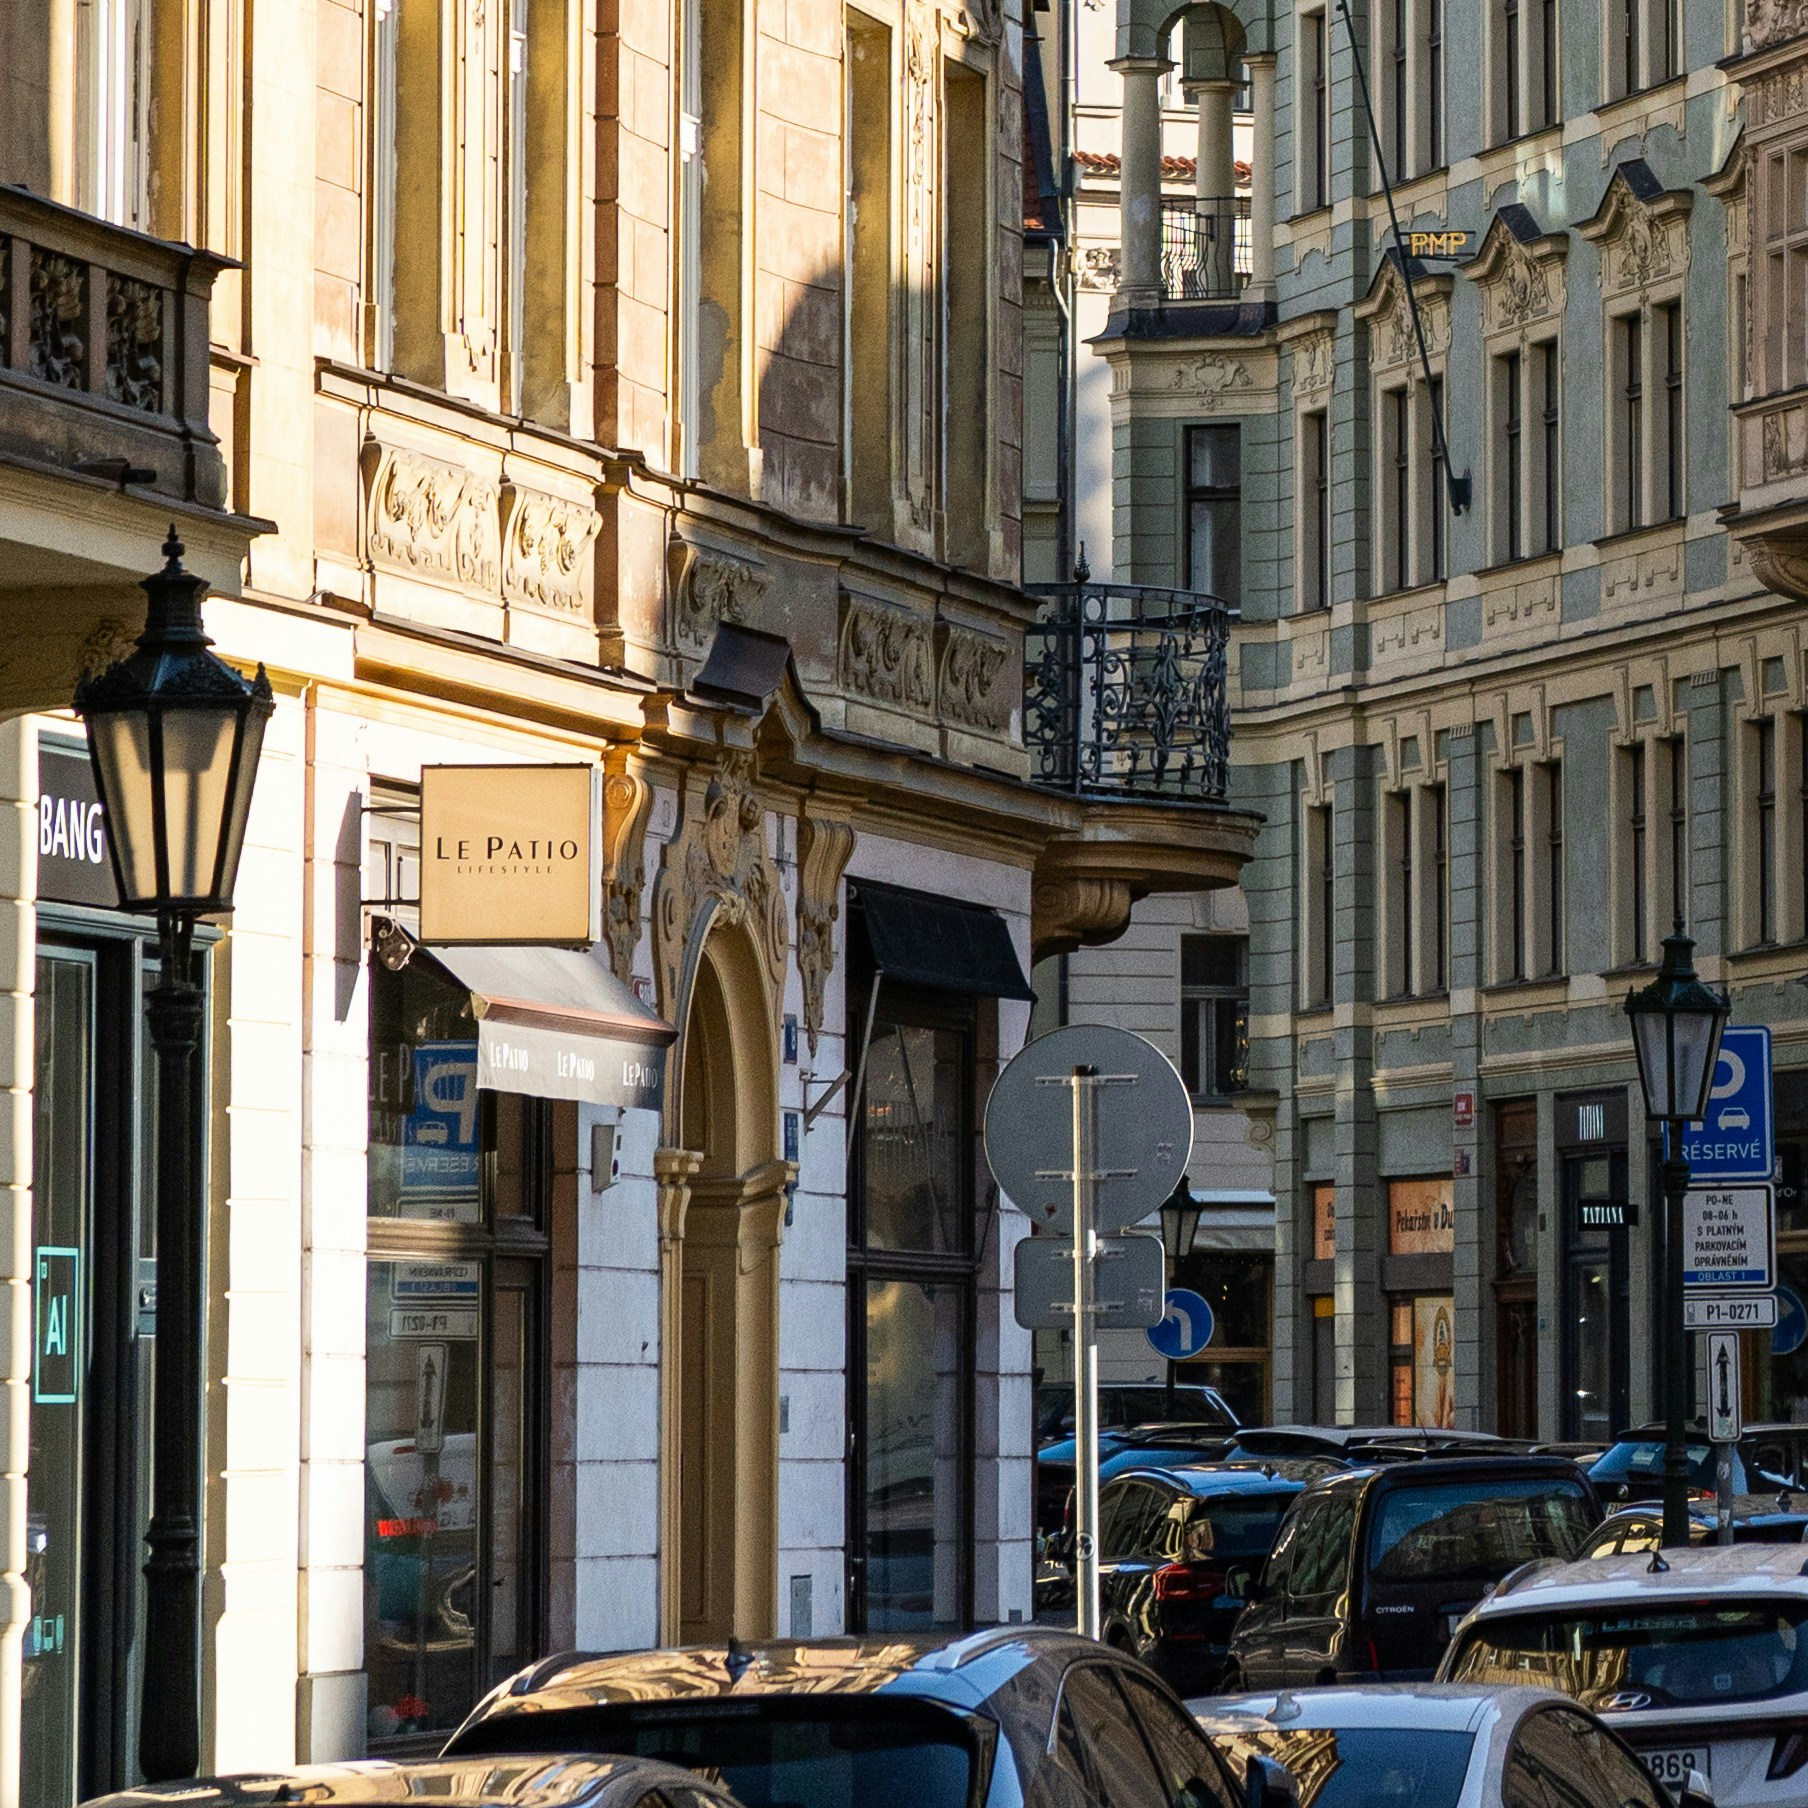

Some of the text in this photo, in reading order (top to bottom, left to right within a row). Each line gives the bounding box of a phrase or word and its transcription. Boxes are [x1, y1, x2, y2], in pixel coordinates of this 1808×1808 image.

[41, 794, 103, 864] BANG
[457, 865, 553, 874] LIFESTYLE
[1705, 1194, 1734, 1206] PO-NE
[1582, 1206, 1624, 1225] TATIANA
[1697, 1222, 1745, 1237] S PLATNÝM
[1695, 1238, 1747, 1252] PARKOVACÍM
[1697, 1271, 1737, 1282] OBLAST
[1706, 1303, 1759, 1321] P1-0271
